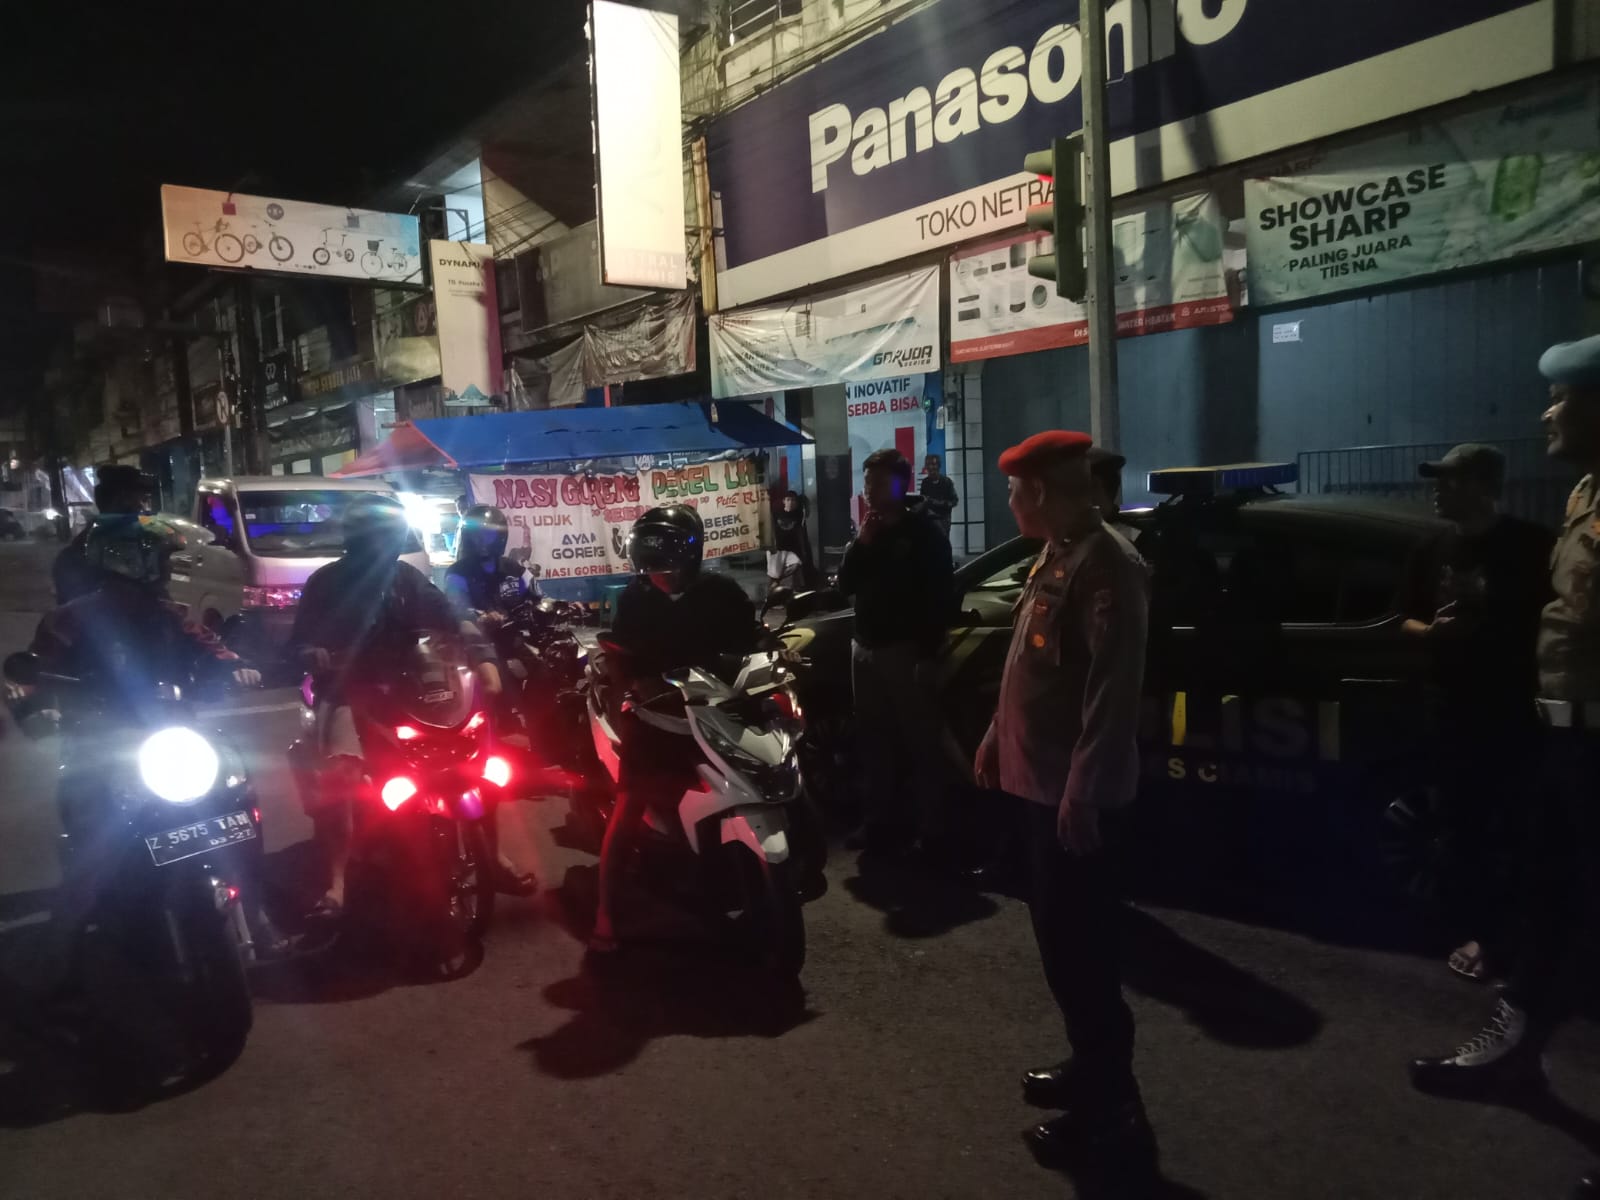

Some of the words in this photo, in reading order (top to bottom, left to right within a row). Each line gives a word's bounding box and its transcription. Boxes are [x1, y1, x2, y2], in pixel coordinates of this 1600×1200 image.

[808, 0, 1247, 194] Panasonic
[1259, 163, 1446, 231] SHOWCASE
[916, 200, 977, 240] TOKO
[1289, 202, 1411, 251] SHARP
[438, 259, 487, 269] DYNAMI
[1288, 247, 1349, 272] PALING
[1351, 234, 1412, 259] JUARA
[1320, 260, 1349, 280] TIIS
[1353, 257, 1379, 274] NA
[854, 377, 911, 399] INOVATIF
[848, 400, 887, 417] SERBA
[890, 396, 920, 412] BISA
[493, 478, 559, 509] NASI
[506, 515, 527, 527] ASI
[545, 567, 571, 578] NASI
[149, 837, 162, 850] Z
[167, 823, 209, 844] 5675
